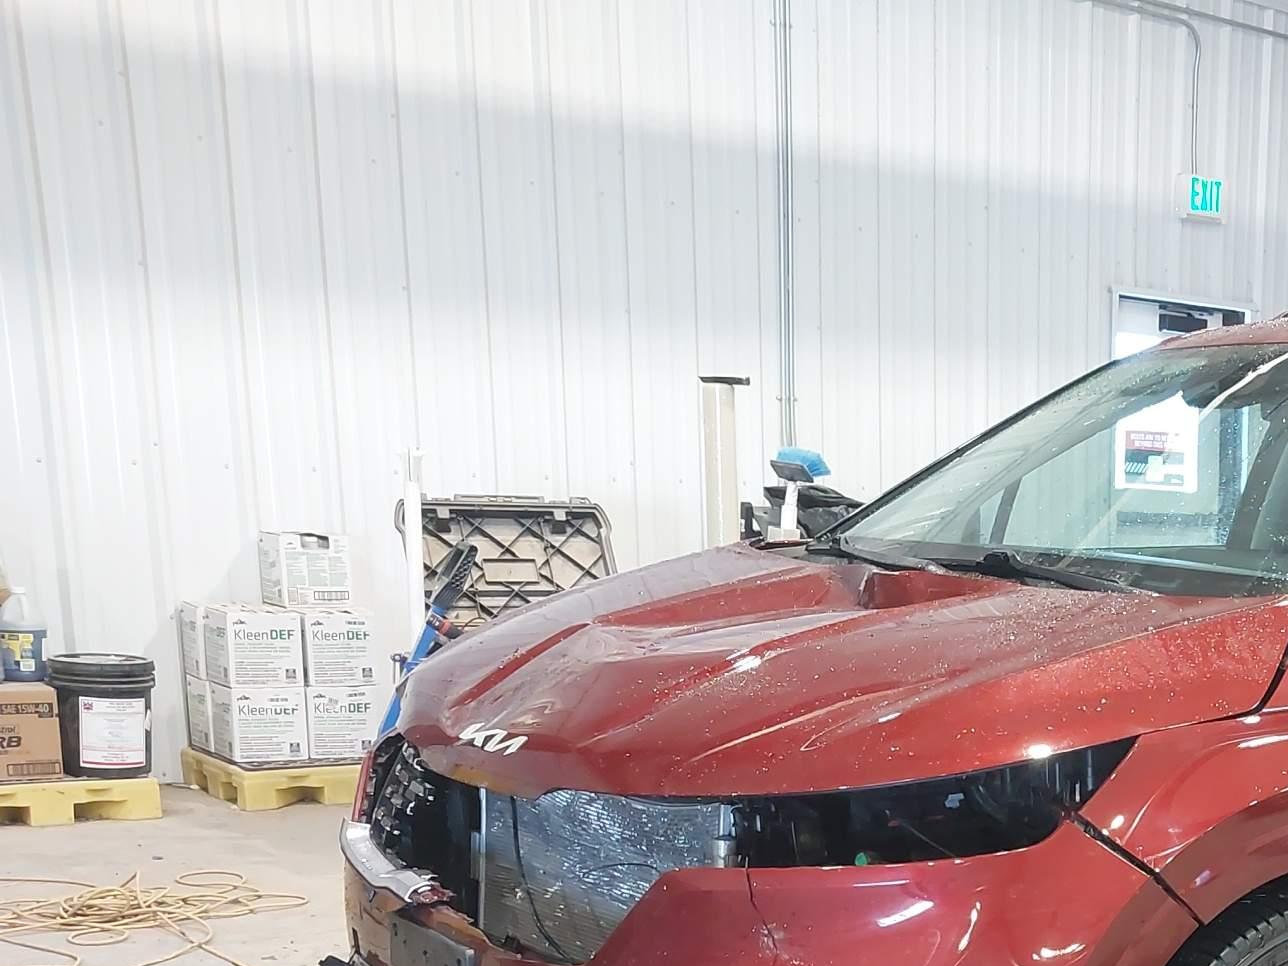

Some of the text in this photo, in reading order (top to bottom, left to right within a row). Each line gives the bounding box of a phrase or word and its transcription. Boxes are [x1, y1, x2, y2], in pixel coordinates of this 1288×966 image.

[1191, 177, 1222, 213] EXIT
[233, 629, 296, 641] KleenDEF
[311, 629, 371, 641] KleenDEF
[18, 703, 49, 714] 15W-40
[458, 722, 529, 756] KIA
